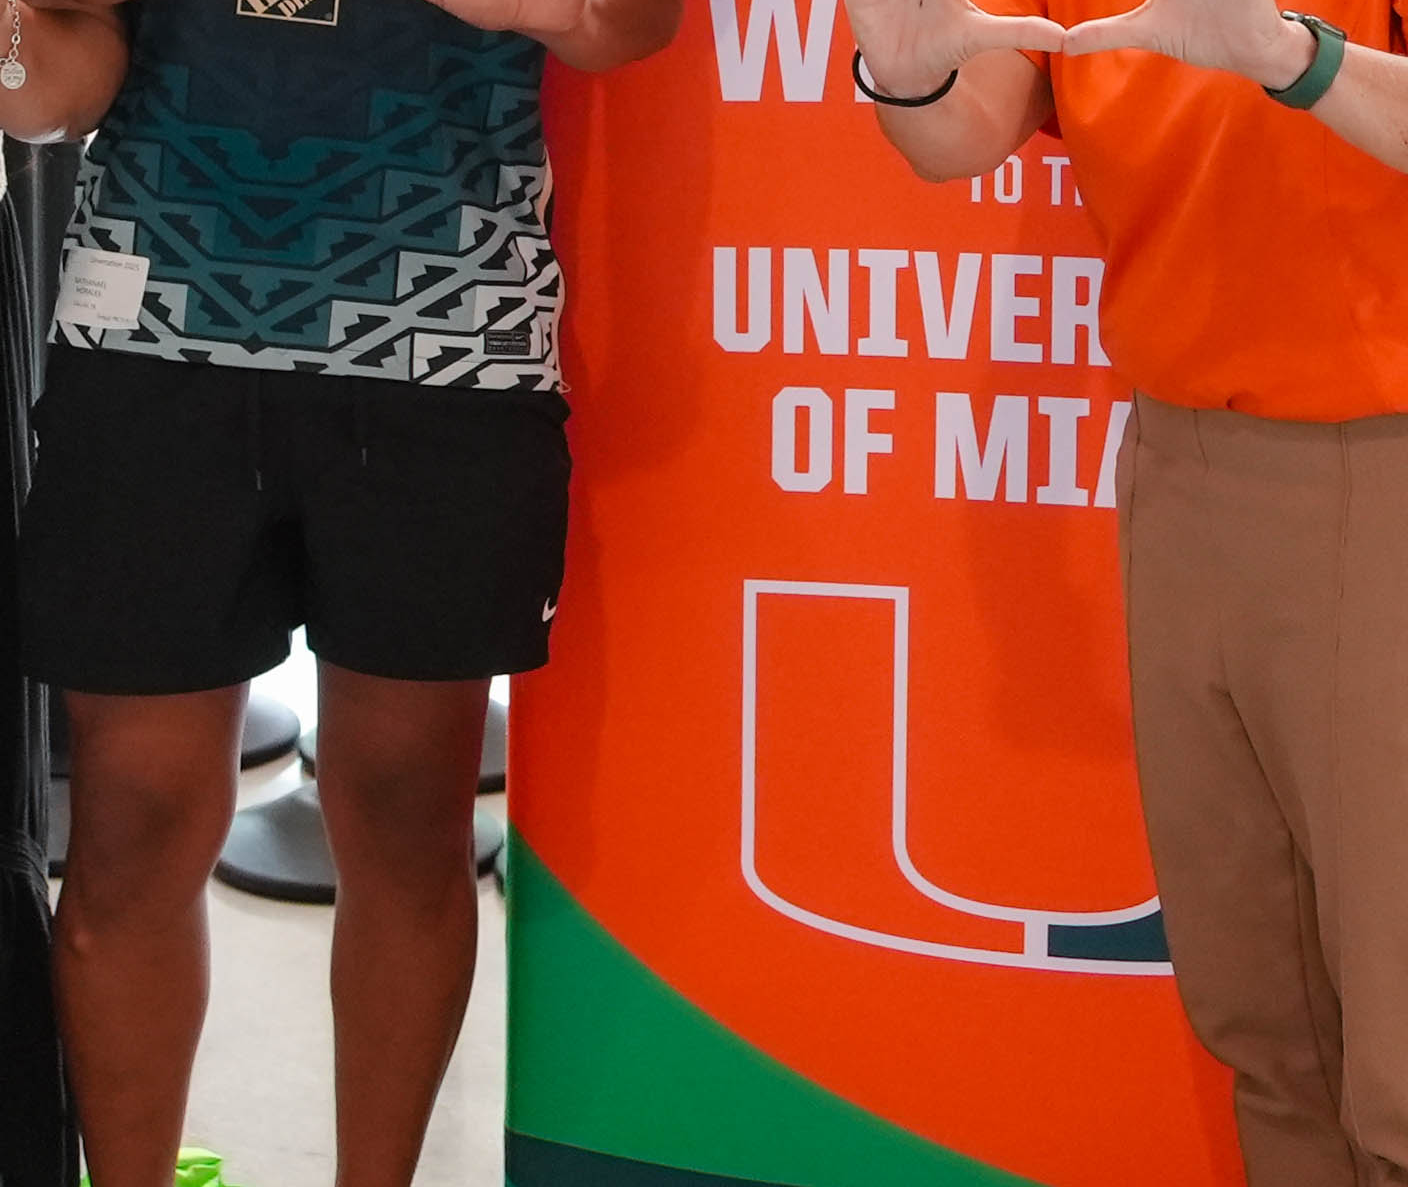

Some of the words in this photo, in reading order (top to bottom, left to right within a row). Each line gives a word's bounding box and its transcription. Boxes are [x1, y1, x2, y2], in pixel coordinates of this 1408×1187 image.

[1041, 155, 1083, 207] T
[712, 246, 1110, 366] UNIVER
[771, 386, 895, 495] OF
